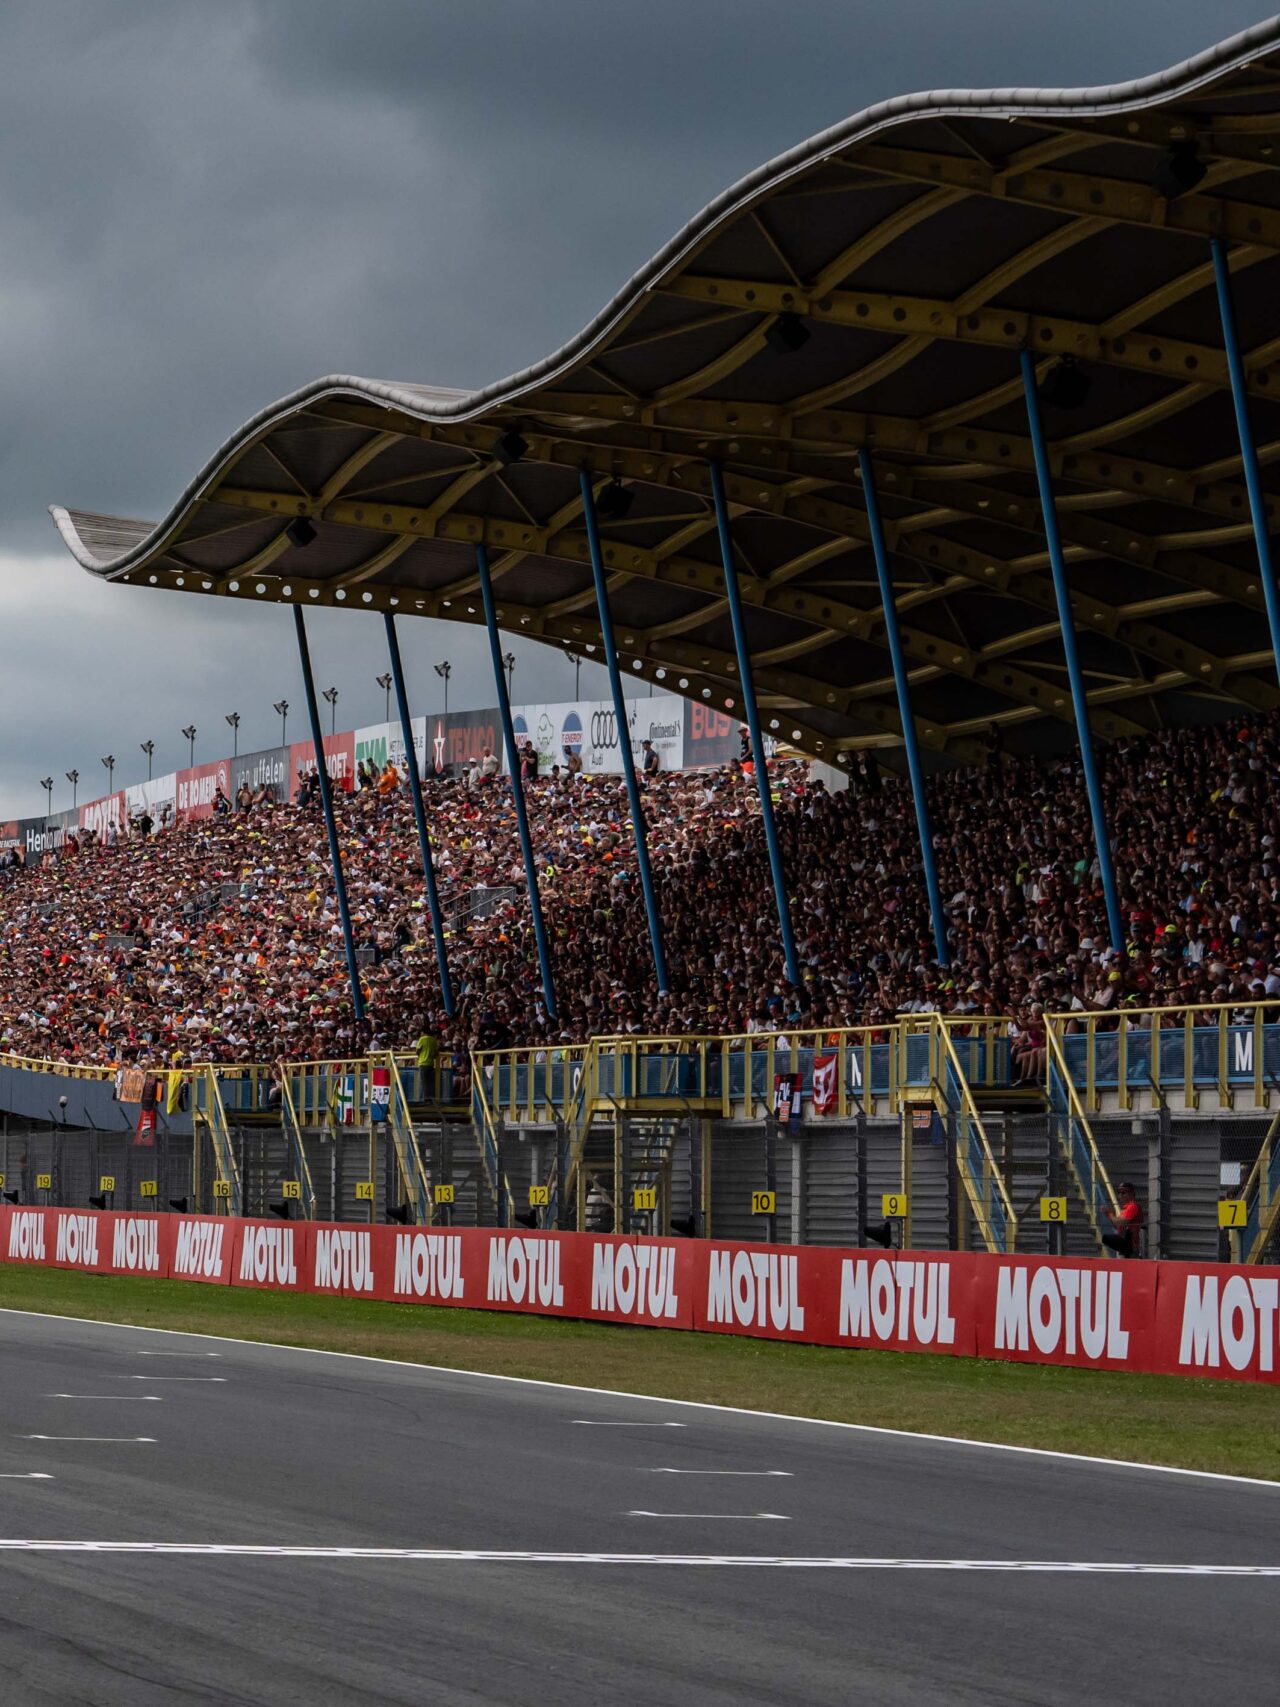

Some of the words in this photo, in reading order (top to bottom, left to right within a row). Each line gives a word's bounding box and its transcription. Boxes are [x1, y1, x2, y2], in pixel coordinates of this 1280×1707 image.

[449, 725, 495, 763] TEXACO
[253, 757, 284, 784] uffelen
[591, 754, 603, 766] Audi
[178, 783, 189, 810] DE
[1234, 1031, 1253, 1072] M
[39, 1176, 50, 1187] 19
[102, 1178, 113, 1189] 18
[143, 1182, 155, 1194] 17
[216, 1183, 229, 1195] 16
[285, 1183, 298, 1197] 15
[358, 1183, 373, 1198] 14
[437, 1186, 452, 1201] 13
[532, 1188, 546, 1204] 12
[638, 1192, 651, 1208] 11
[754, 1195, 771, 1211] 10
[888, 1197, 899, 1214] 9
[1048, 1201, 1060, 1219] 8
[1228, 1205, 1238, 1224] 7
[8, 1212, 45, 1260] MOTUL
[56, 1213, 99, 1266] MOTUL
[112, 1218, 159, 1271] MOTUL
[175, 1220, 224, 1277] MOTUL
[240, 1225, 297, 1285] MOTUL
[315, 1229, 374, 1291] MOTUL
[393, 1232, 464, 1299] MOTUL
[487, 1236, 563, 1306] MOTUL
[591, 1243, 677, 1319] MOTUL
[707, 1250, 804, 1331] MOTUL
[839, 1258, 955, 1344] MOTUL
[994, 1266, 1129, 1360] MOTUL
[1179, 1274, 1280, 1372] MOT
